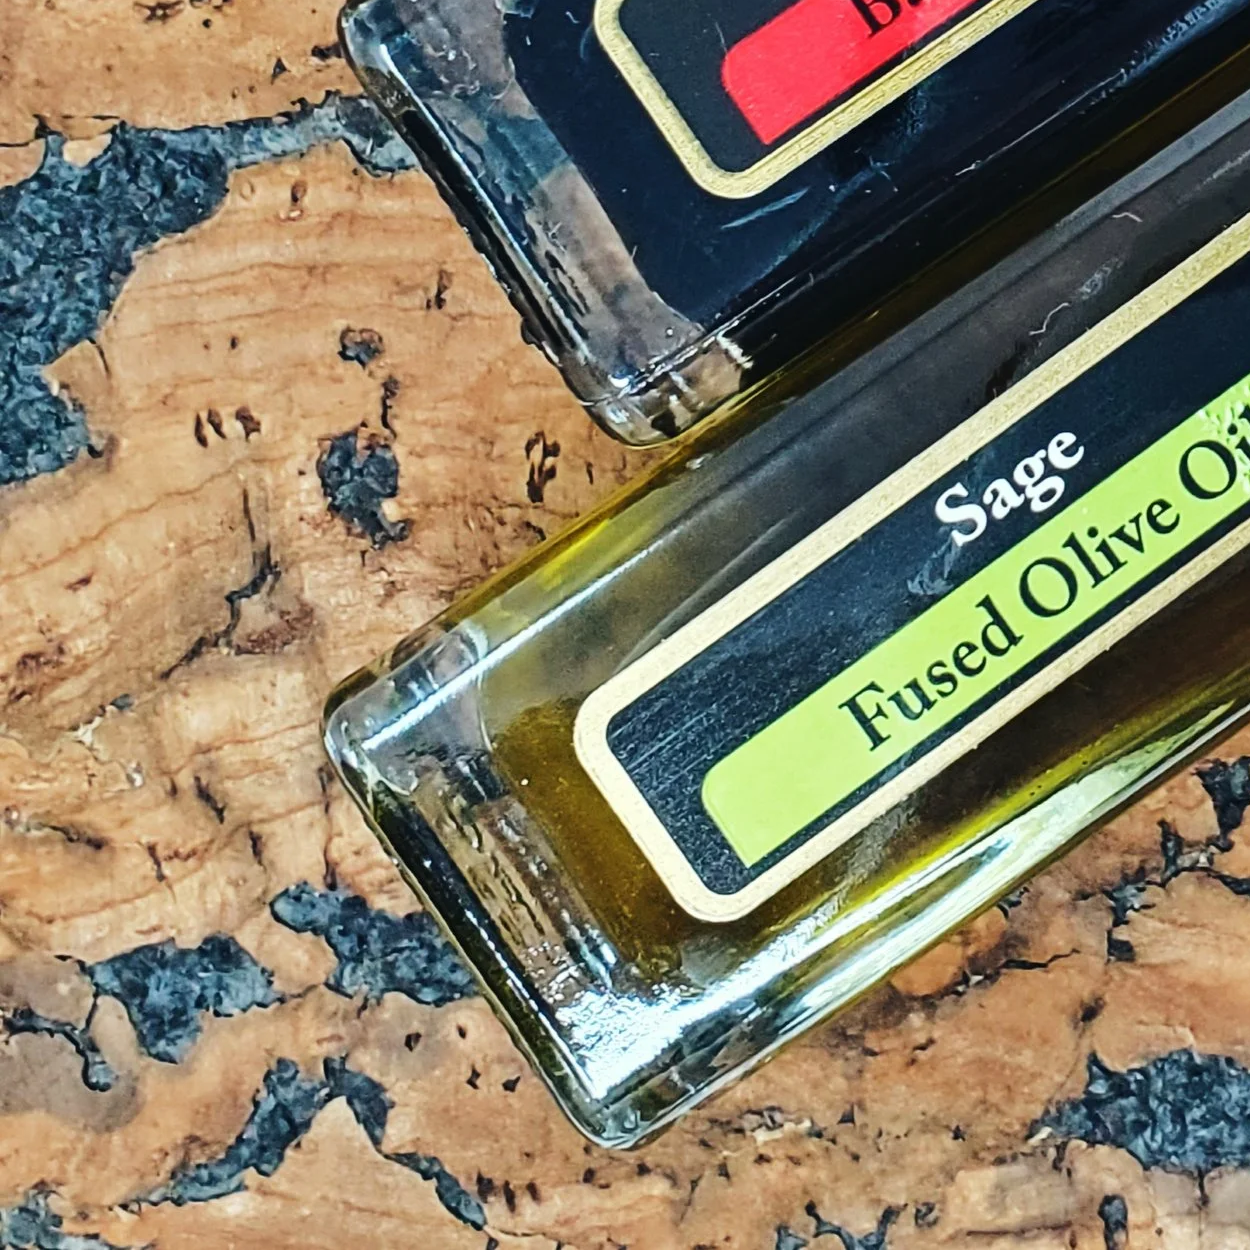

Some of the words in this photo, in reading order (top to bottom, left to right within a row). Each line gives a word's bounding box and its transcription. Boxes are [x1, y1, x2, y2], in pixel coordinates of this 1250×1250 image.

[934, 431, 1085, 546] Sage
[838, 594, 1024, 752] Fused
[1018, 497, 1181, 619] Olive
